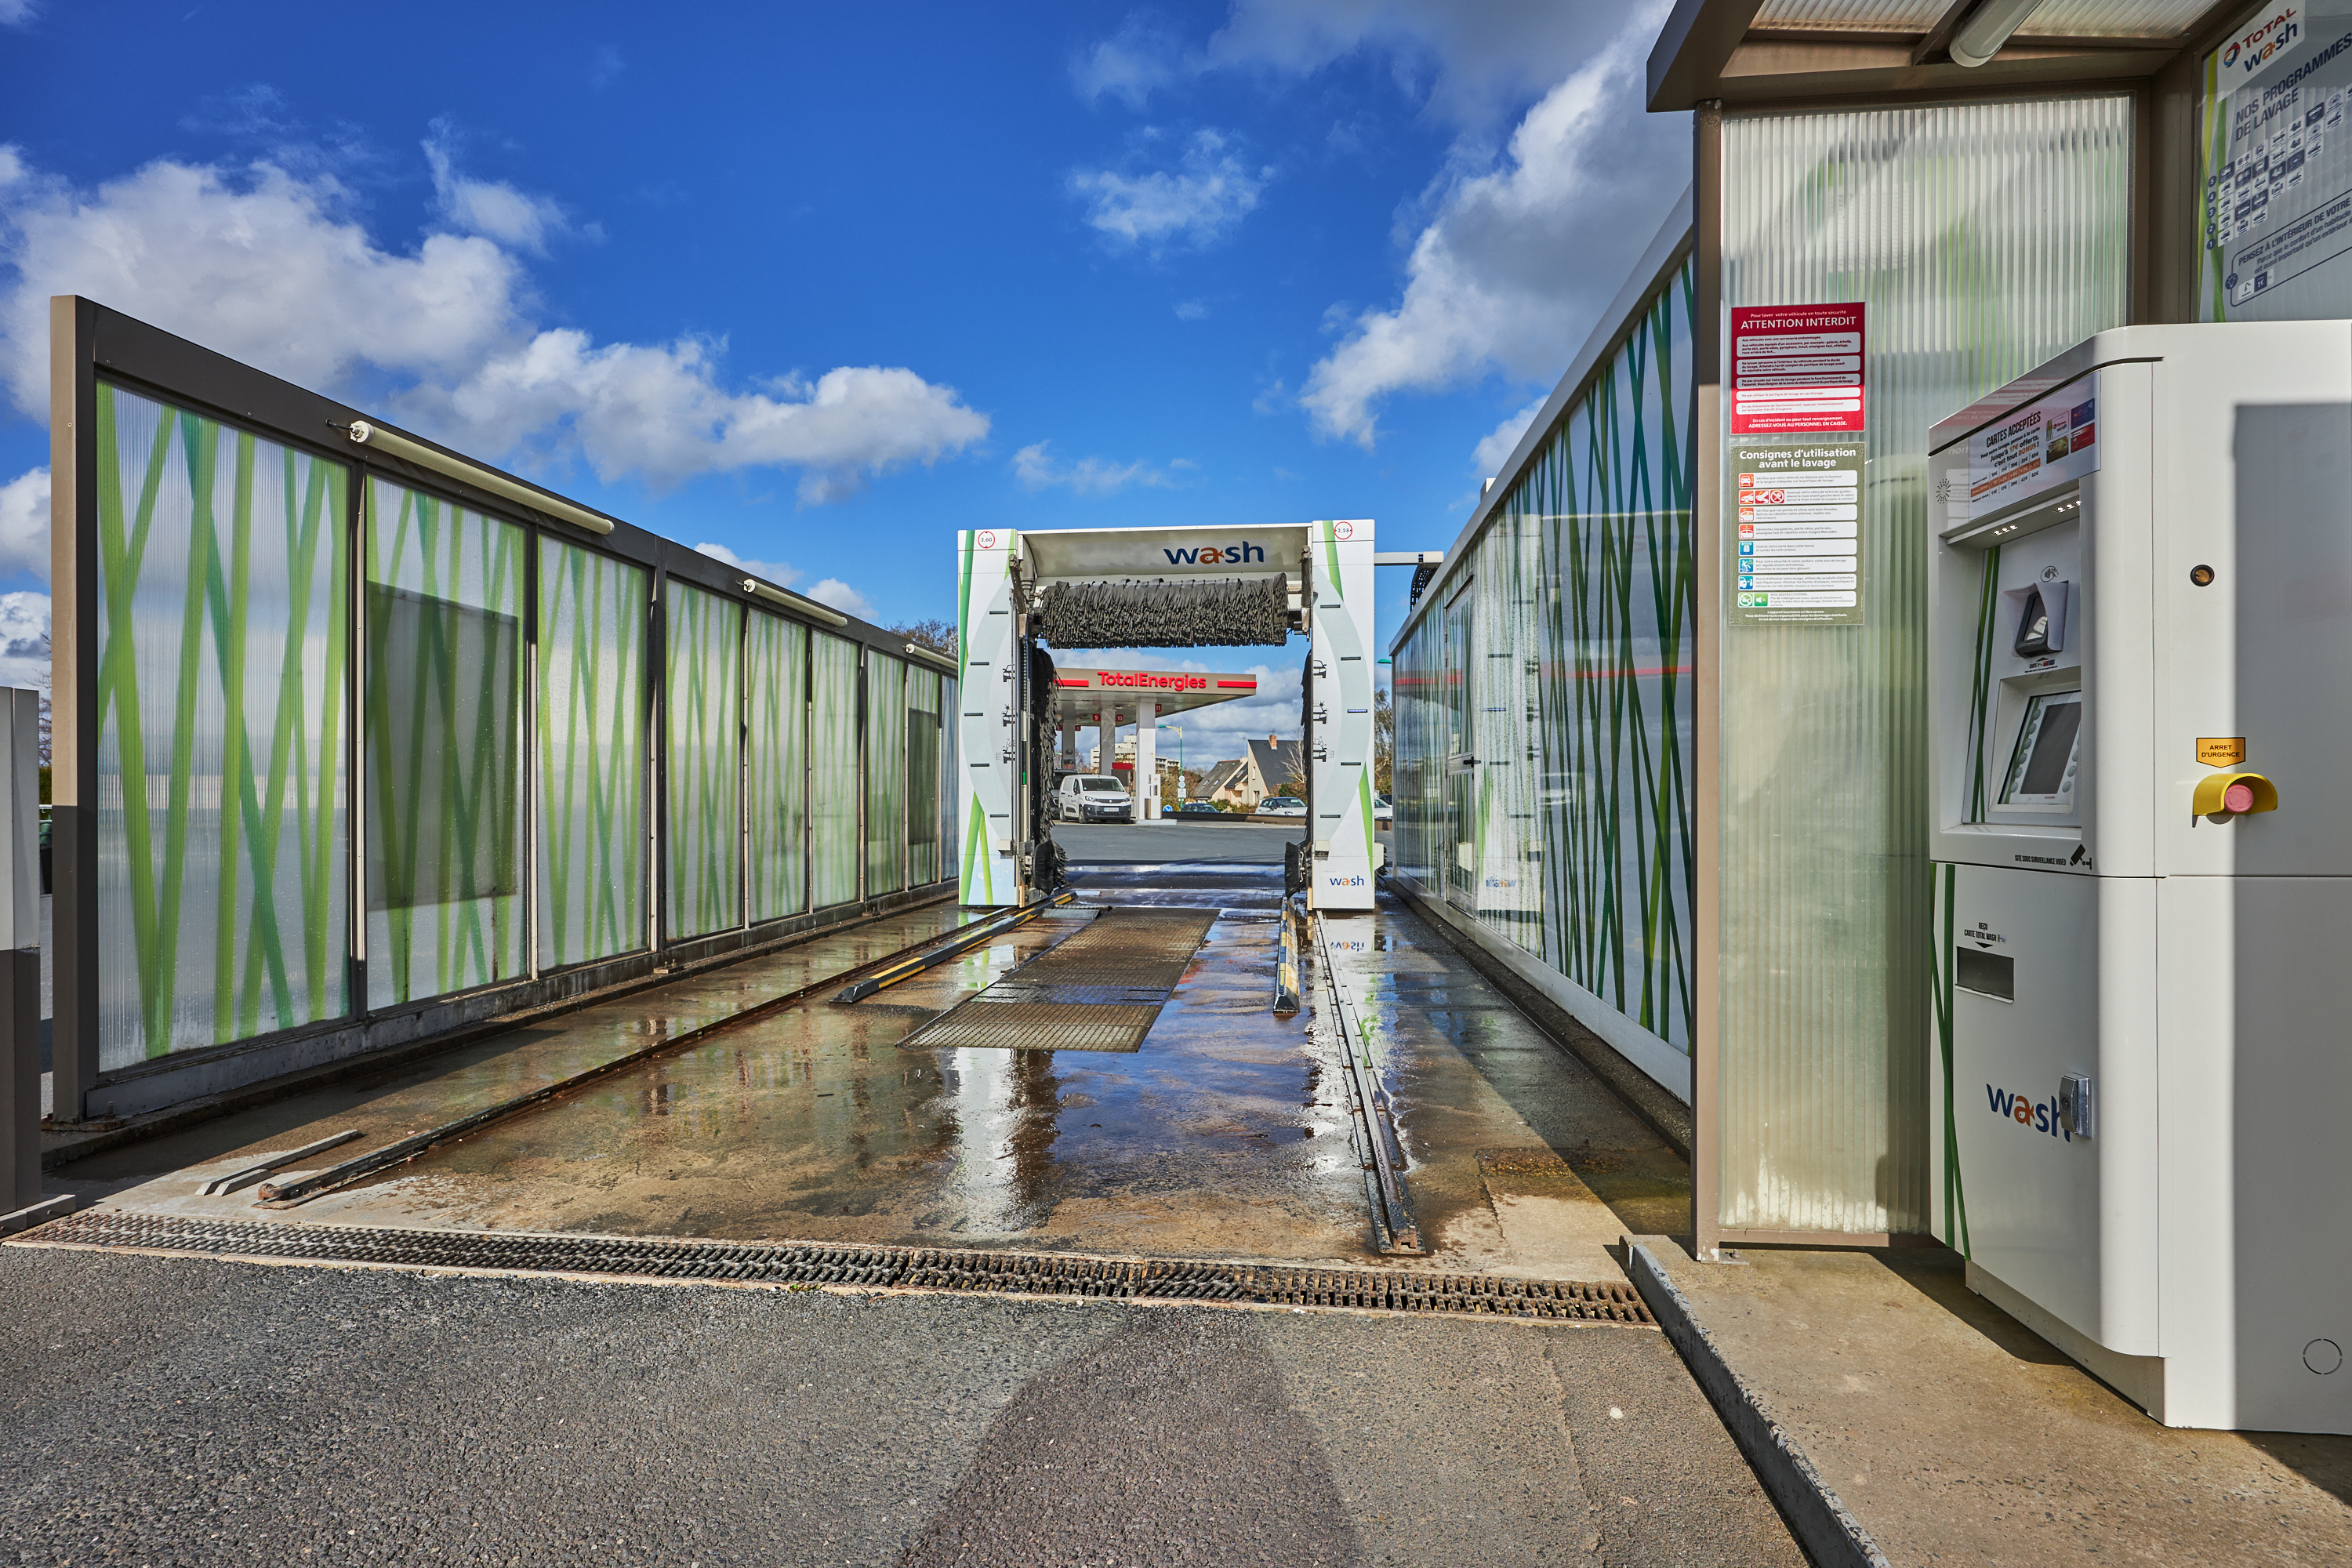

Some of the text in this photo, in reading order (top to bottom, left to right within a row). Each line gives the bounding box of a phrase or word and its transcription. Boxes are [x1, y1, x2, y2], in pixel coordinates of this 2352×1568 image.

[2242, 8, 2296, 48] TOTAL
[2244, 23, 2297, 72] wash
[2236, 32, 2352, 125] NOS PROGRAMMES
[2236, 121, 2251, 143] DE
[2254, 88, 2298, 129] LAVAGE
[2239, 198, 2350, 266] PENSEZ À L'INTÉRIEUR DE VOTRE
[2257, 253, 2272, 265] Parce
[2274, 247, 2283, 256] que
[2290, 231, 2310, 247] confort
[2311, 224, 2323, 235] d'un
[2325, 210, 2350, 228] habitacle
[2278, 243, 2303, 261] important
[2305, 235, 2321, 247] qu'un
[2322, 220, 2348, 238] extérieur
[2258, 279, 2264, 288] 1€
[1741, 317, 1857, 329] ATTENTION INTERDIT
[1987, 429, 2007, 448] CARTES
[2008, 412, 2041, 437] ACCEPTÉES
[1740, 448, 1856, 460] Consignes d'utilisation
[1991, 449, 2008, 462] Jusqu'à
[2020, 435, 2039, 447] offerts,
[1994, 458, 2005, 467] c'est
[2007, 452, 2017, 461] tout
[2019, 443, 2036, 456] BONUS
[1759, 459, 1836, 469] avant le lavage
[1163, 541, 1264, 564] wash
[1098, 672, 1207, 691] TotalEnergies
[2031, 856, 2055, 865] SURVEILLANCE
[1330, 875, 1364, 886] wash
[1965, 929, 1975, 938] CARTE
[1986, 933, 1996, 942] WASH
[1979, 922, 1987, 931] REÇU
[1986, 1083, 2071, 1142] wash
